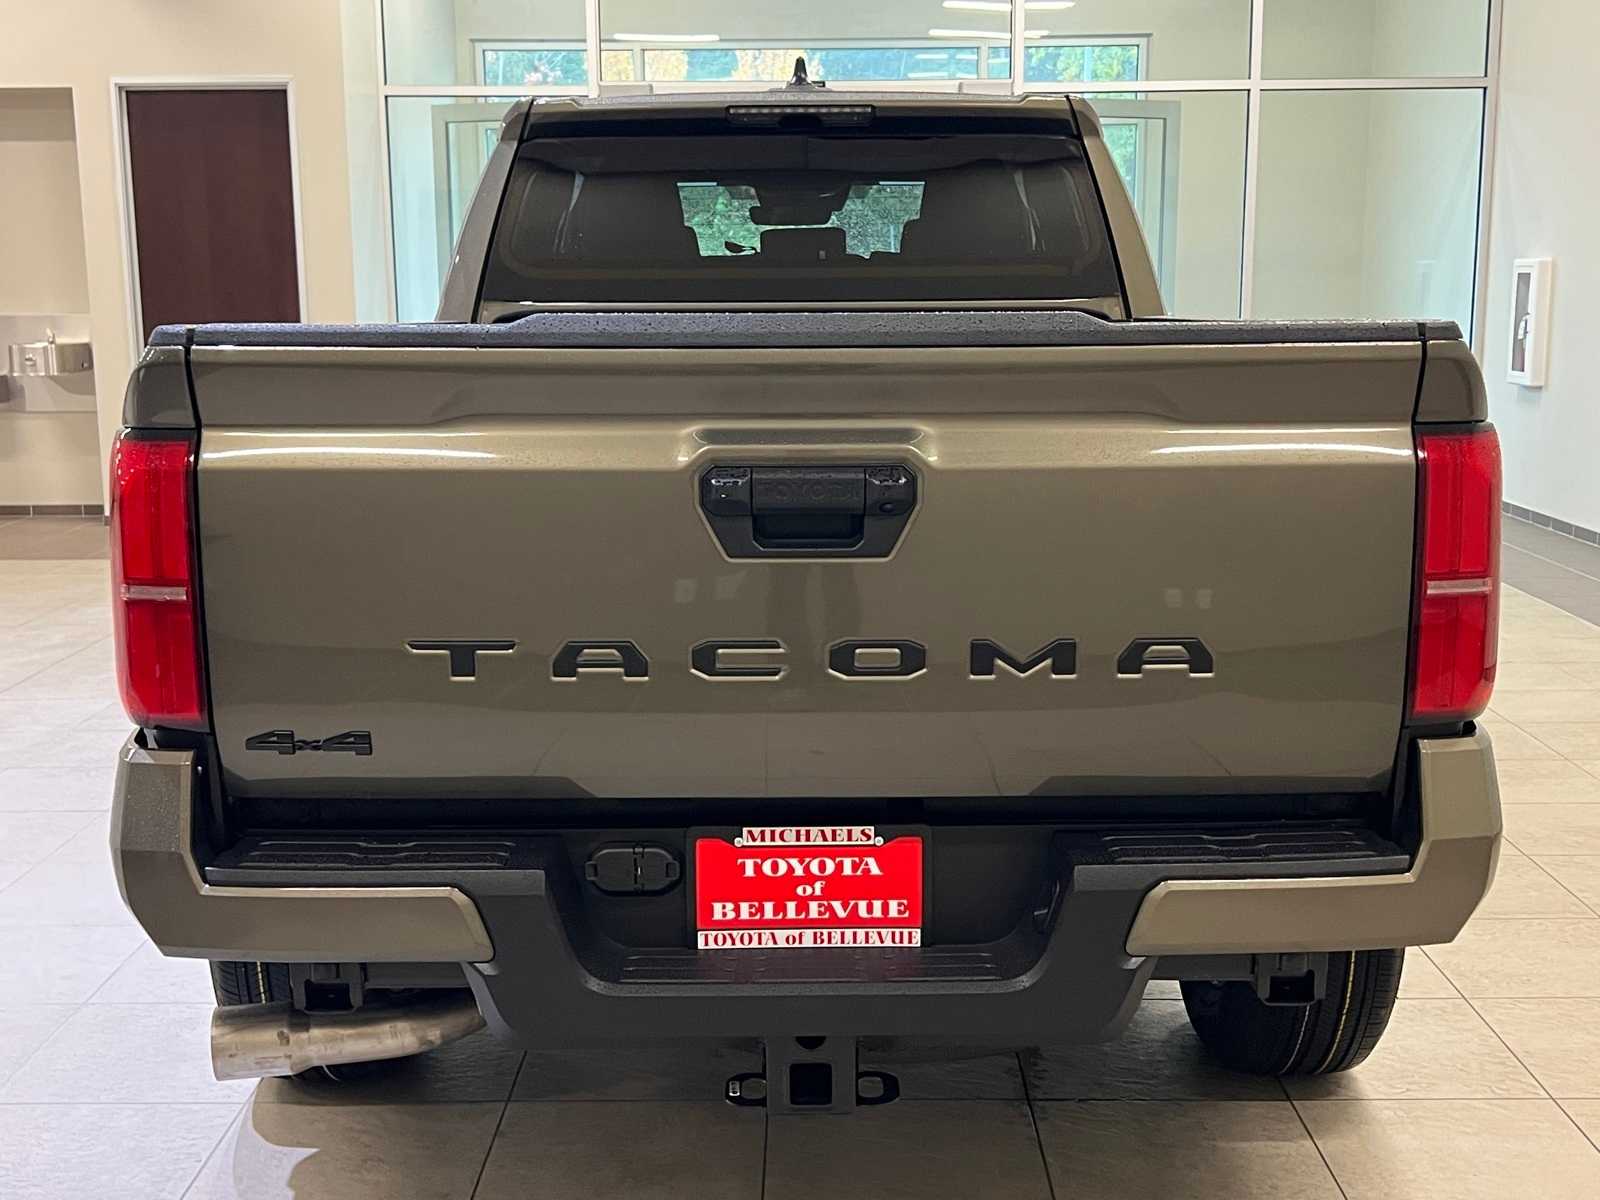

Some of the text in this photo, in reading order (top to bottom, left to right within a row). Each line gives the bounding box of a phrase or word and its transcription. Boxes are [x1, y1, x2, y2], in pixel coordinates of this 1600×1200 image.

[405, 638, 1216, 682] TACOMA
[745, 828, 873, 843] MICHAELS
[736, 856, 883, 877] TOYOTA
[796, 880, 826, 896] of
[711, 899, 910, 921] BELLEVUE
[699, 930, 919, 948] TOYOTA of BELLEVUE
